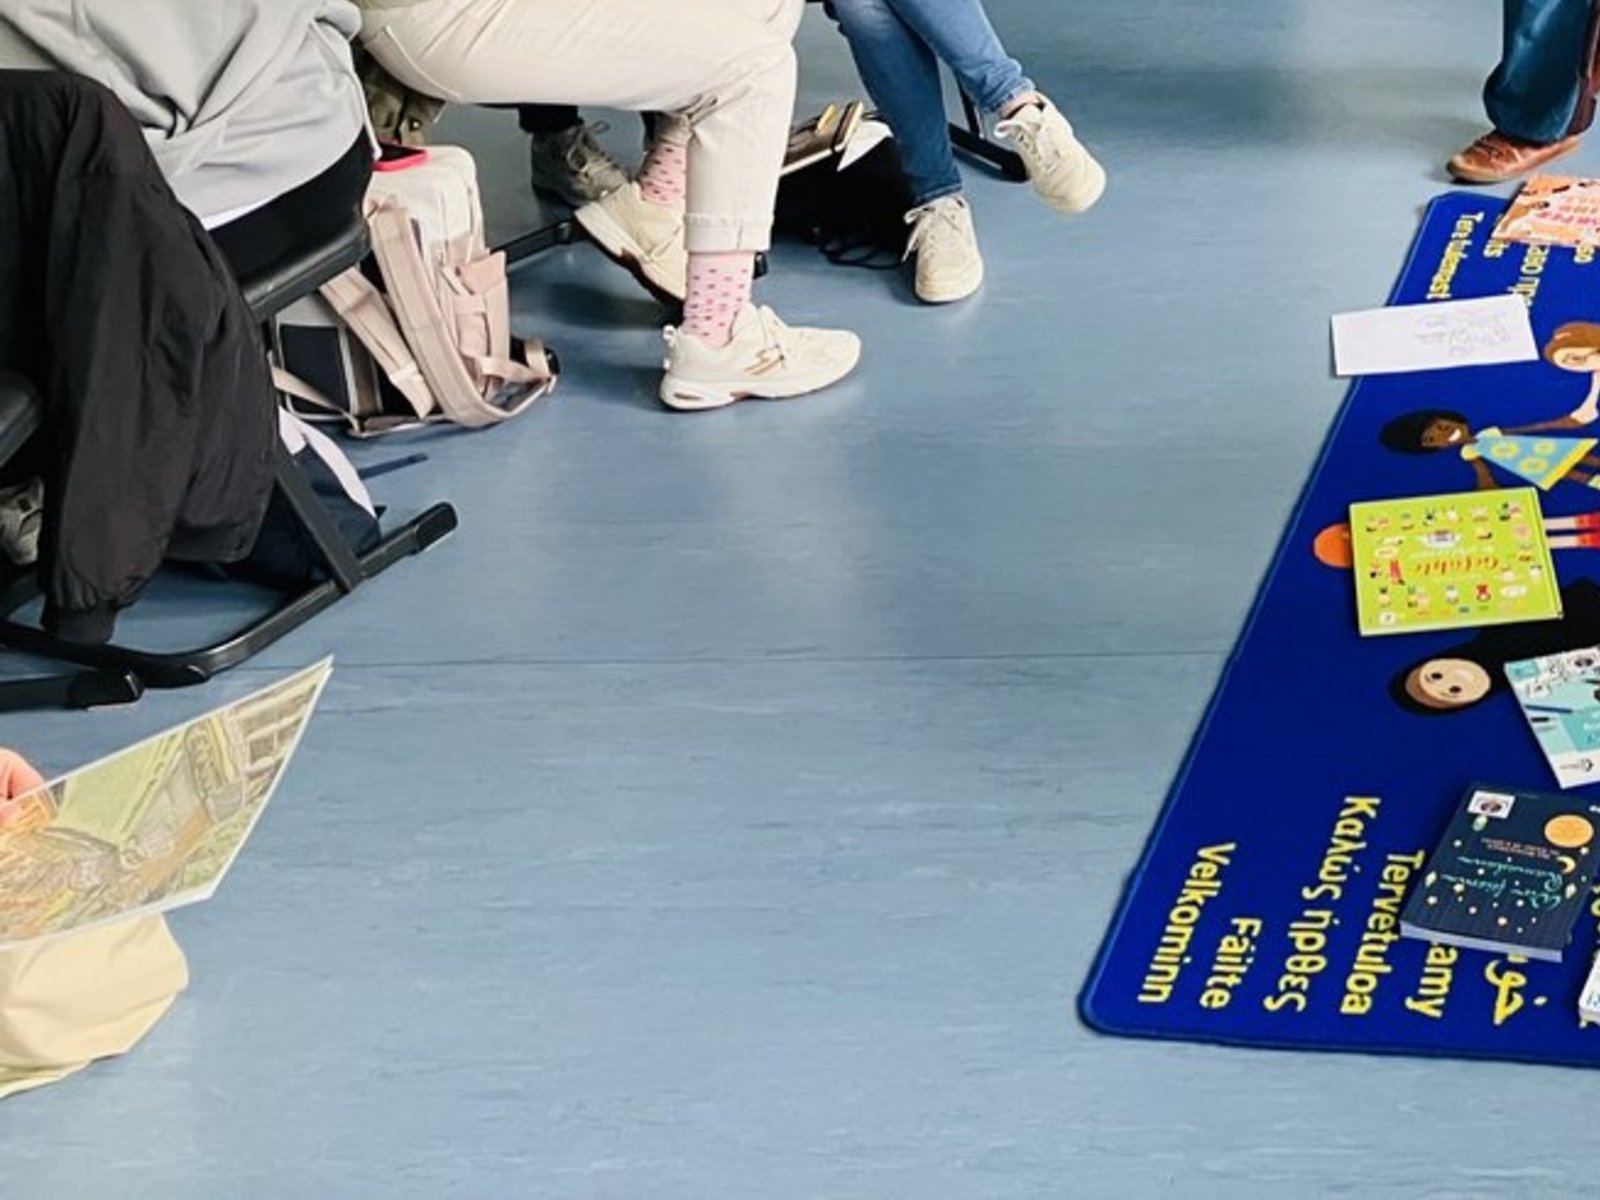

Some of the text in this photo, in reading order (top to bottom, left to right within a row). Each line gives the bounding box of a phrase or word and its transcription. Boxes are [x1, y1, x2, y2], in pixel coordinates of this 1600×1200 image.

[1138, 841, 1237, 1003] Velkominn
[1199, 916, 1263, 1009] Fáilte
[1263, 796, 1381, 1013] Καλώς ήρθες
[1338, 850, 1426, 1015] Tervetuloa
